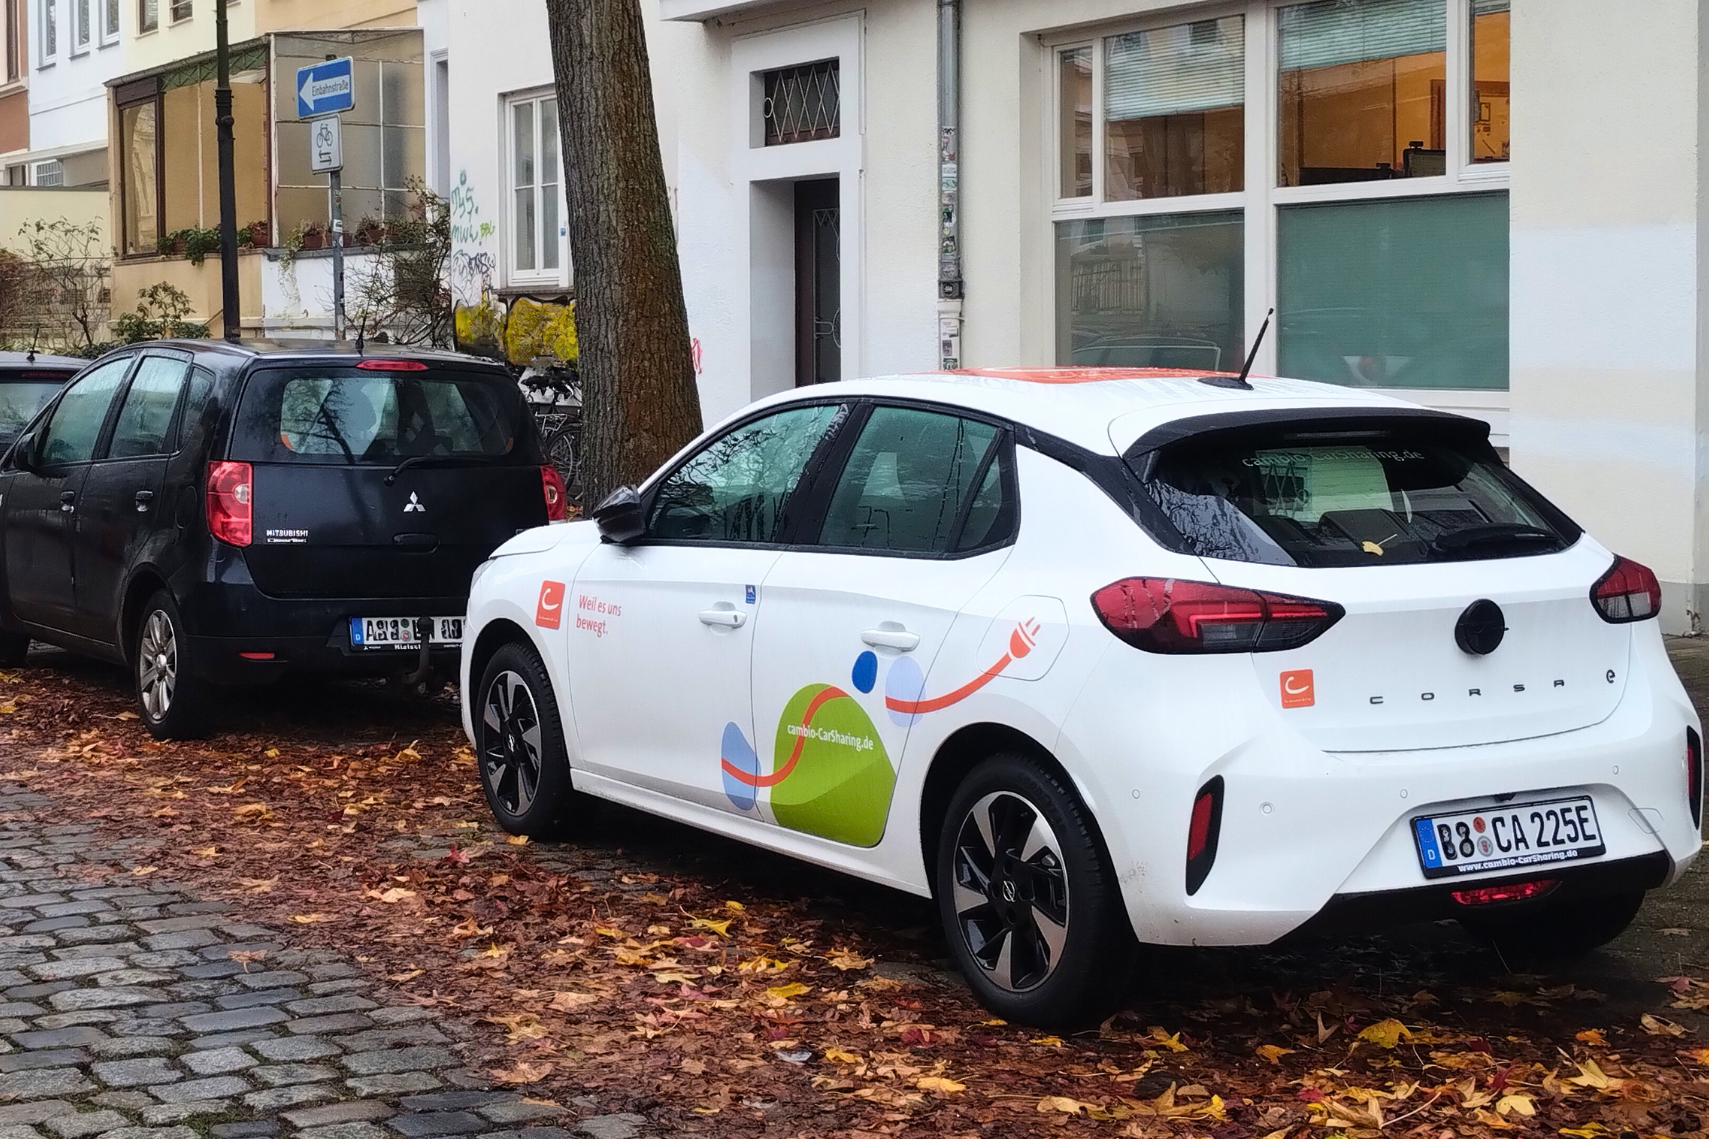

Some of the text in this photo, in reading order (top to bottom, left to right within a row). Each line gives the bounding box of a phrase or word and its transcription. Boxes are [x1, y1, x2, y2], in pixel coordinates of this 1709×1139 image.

[312, 79, 349, 97] Einbahnstraße
[1241, 449, 1426, 468] cambio-CarSharing.de
[266, 529, 309, 537] MITSUBISHI
[579, 594, 622, 617] Weil es uns
[576, 613, 609, 638] bewegt.
[1369, 679, 1565, 705] CORSA
[787, 723, 874, 752] cambio-CarSharing.de
[1427, 848, 1436, 860] D
[1491, 814, 1530, 853] CA
[1530, 805, 1597, 848] 225E
[1457, 849, 1579, 873] www.cambio-CarSharing.de
